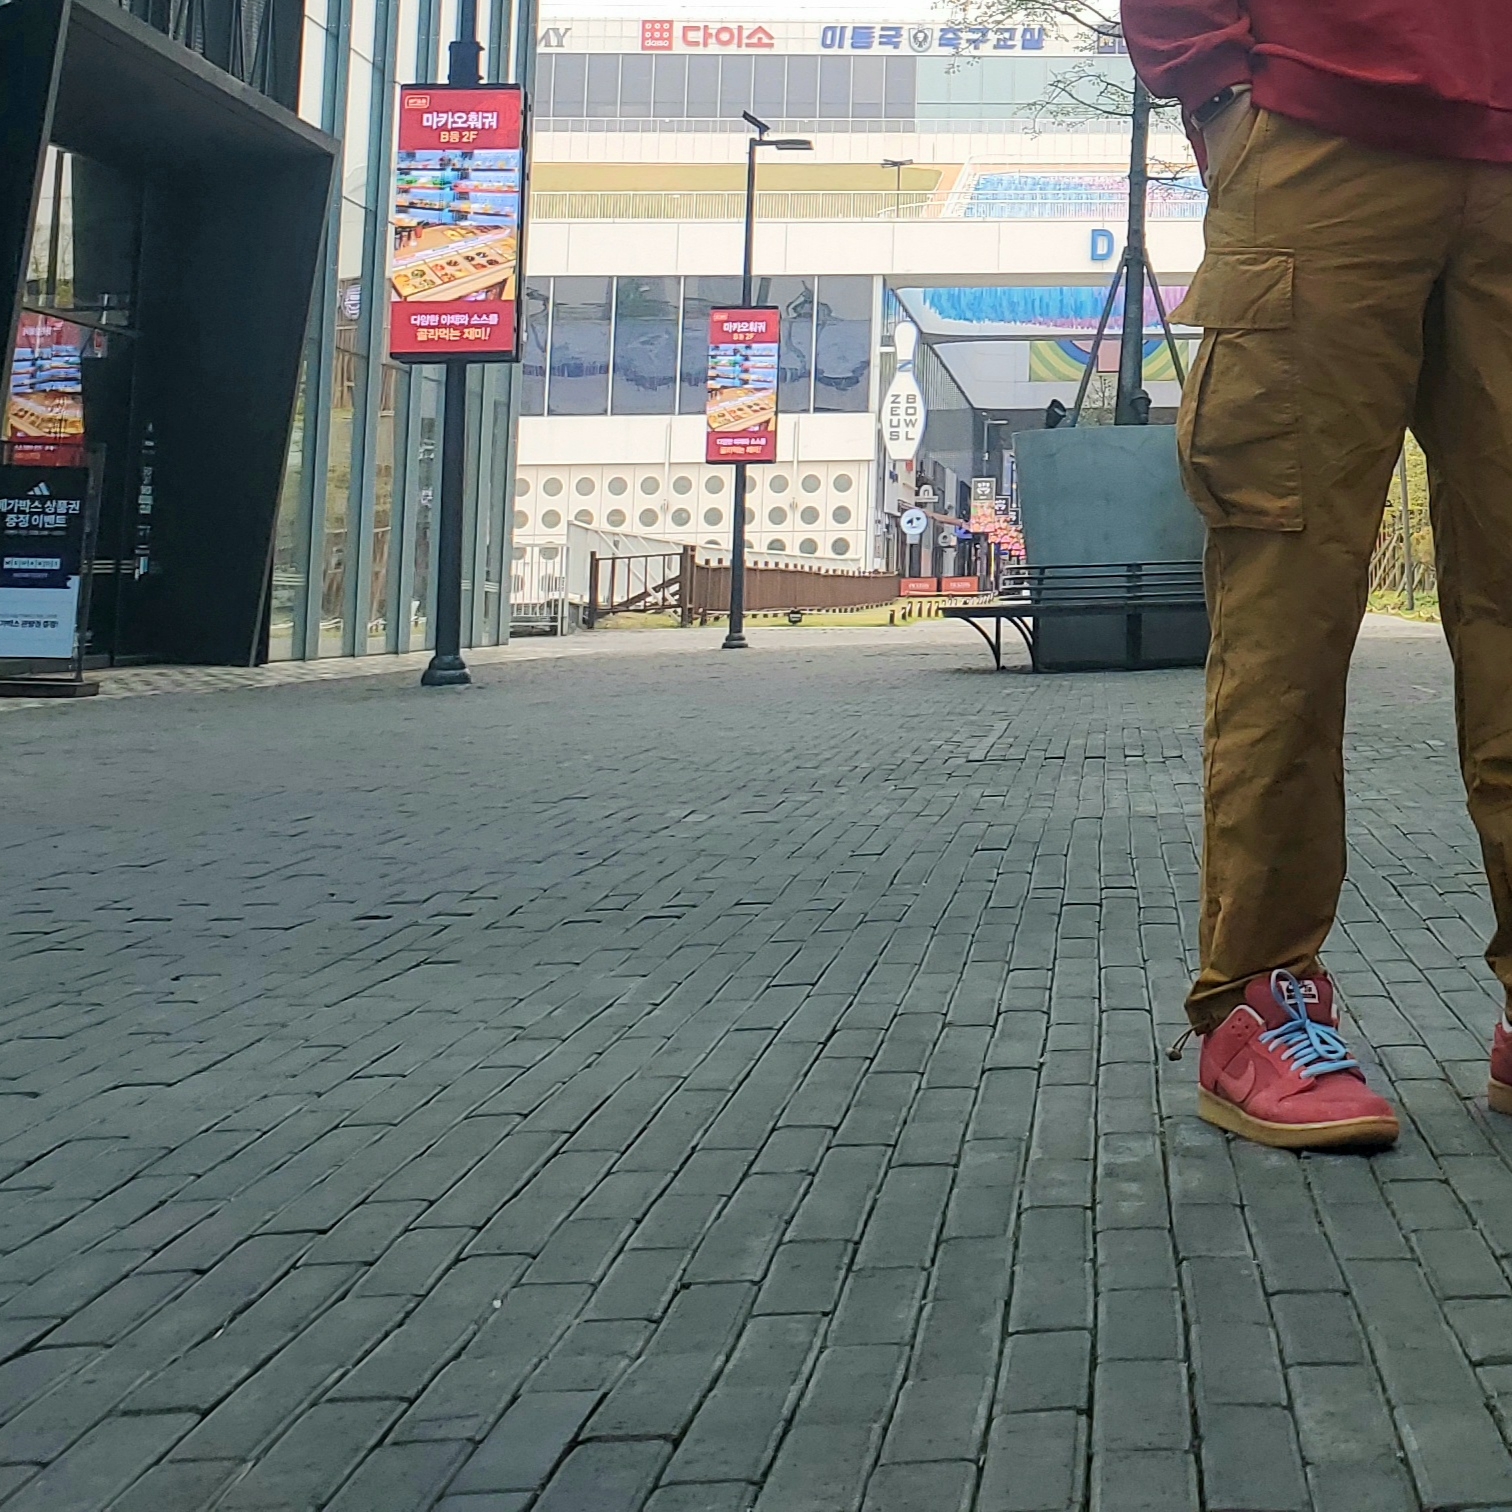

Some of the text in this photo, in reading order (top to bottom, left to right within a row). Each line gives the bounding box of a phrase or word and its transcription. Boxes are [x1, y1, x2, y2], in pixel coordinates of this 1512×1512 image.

[682, 24, 775, 48] 다이소
[821, 25, 1045, 50] 이동국 축구교실
[440, 131, 478, 143] B동 2F
[1091, 228, 1114, 261] D
[889, 393, 902, 441] ZEUS
[904, 393, 918, 441] BOWL
[44, 499, 80, 513] 상품권
[31, 514, 67, 528] 이벤트
